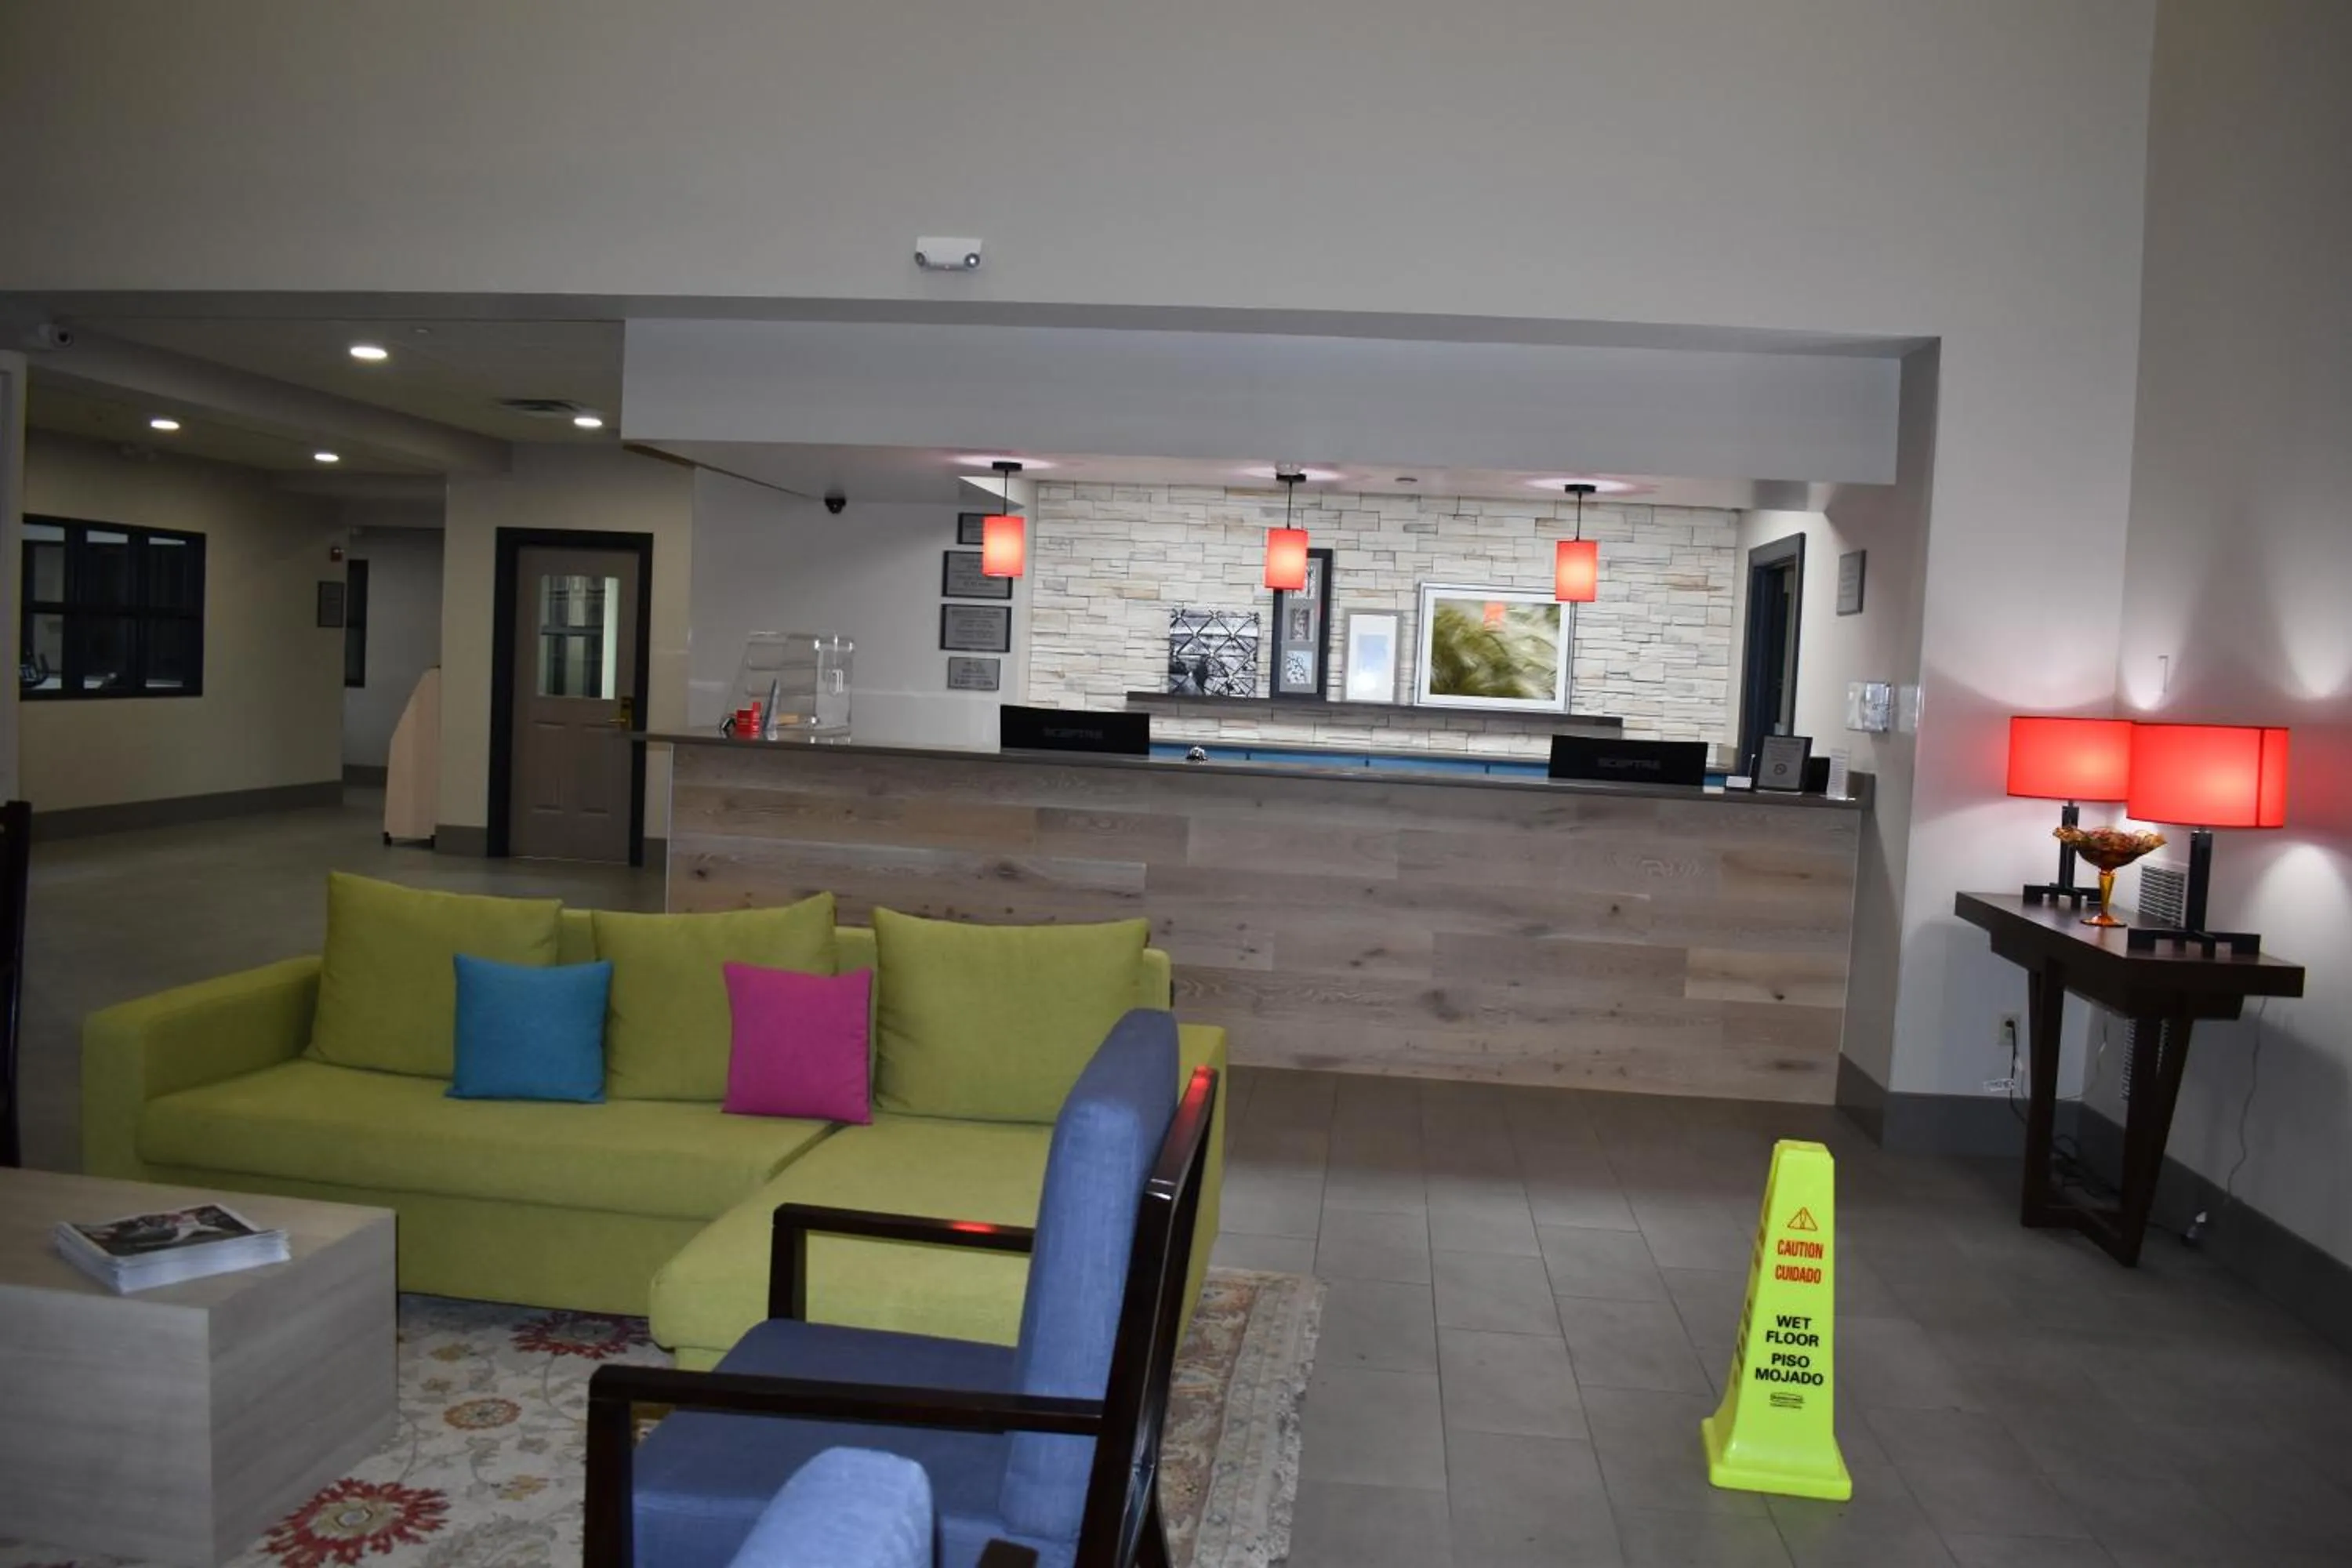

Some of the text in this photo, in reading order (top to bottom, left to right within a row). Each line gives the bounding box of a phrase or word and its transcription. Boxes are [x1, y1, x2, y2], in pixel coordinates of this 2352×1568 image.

[1777, 1240, 1824, 1259] CAUTION
[1775, 1265, 1821, 1283] CUIDADO
[1776, 1315, 1812, 1330] WET
[1766, 1330, 1819, 1347] FLOOR
[1771, 1352, 1810, 1368] PISO
[1755, 1367, 1824, 1386] MOJADO
